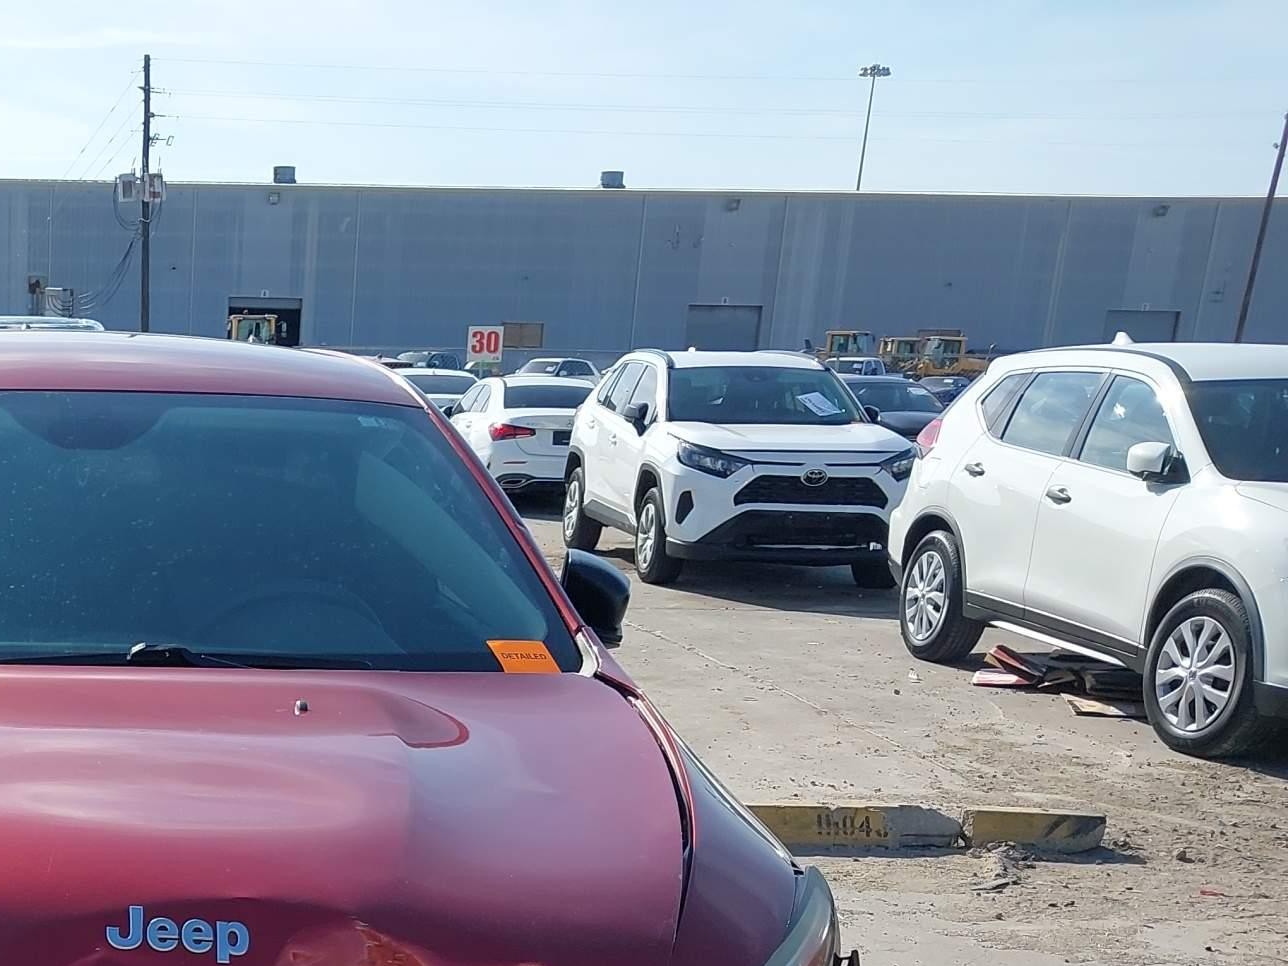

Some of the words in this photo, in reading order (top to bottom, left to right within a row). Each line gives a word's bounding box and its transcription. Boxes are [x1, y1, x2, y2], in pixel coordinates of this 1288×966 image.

[471, 331, 500, 354] 30
[501, 652, 547, 660] DETAILED
[106, 905, 250, 964] Jeep
